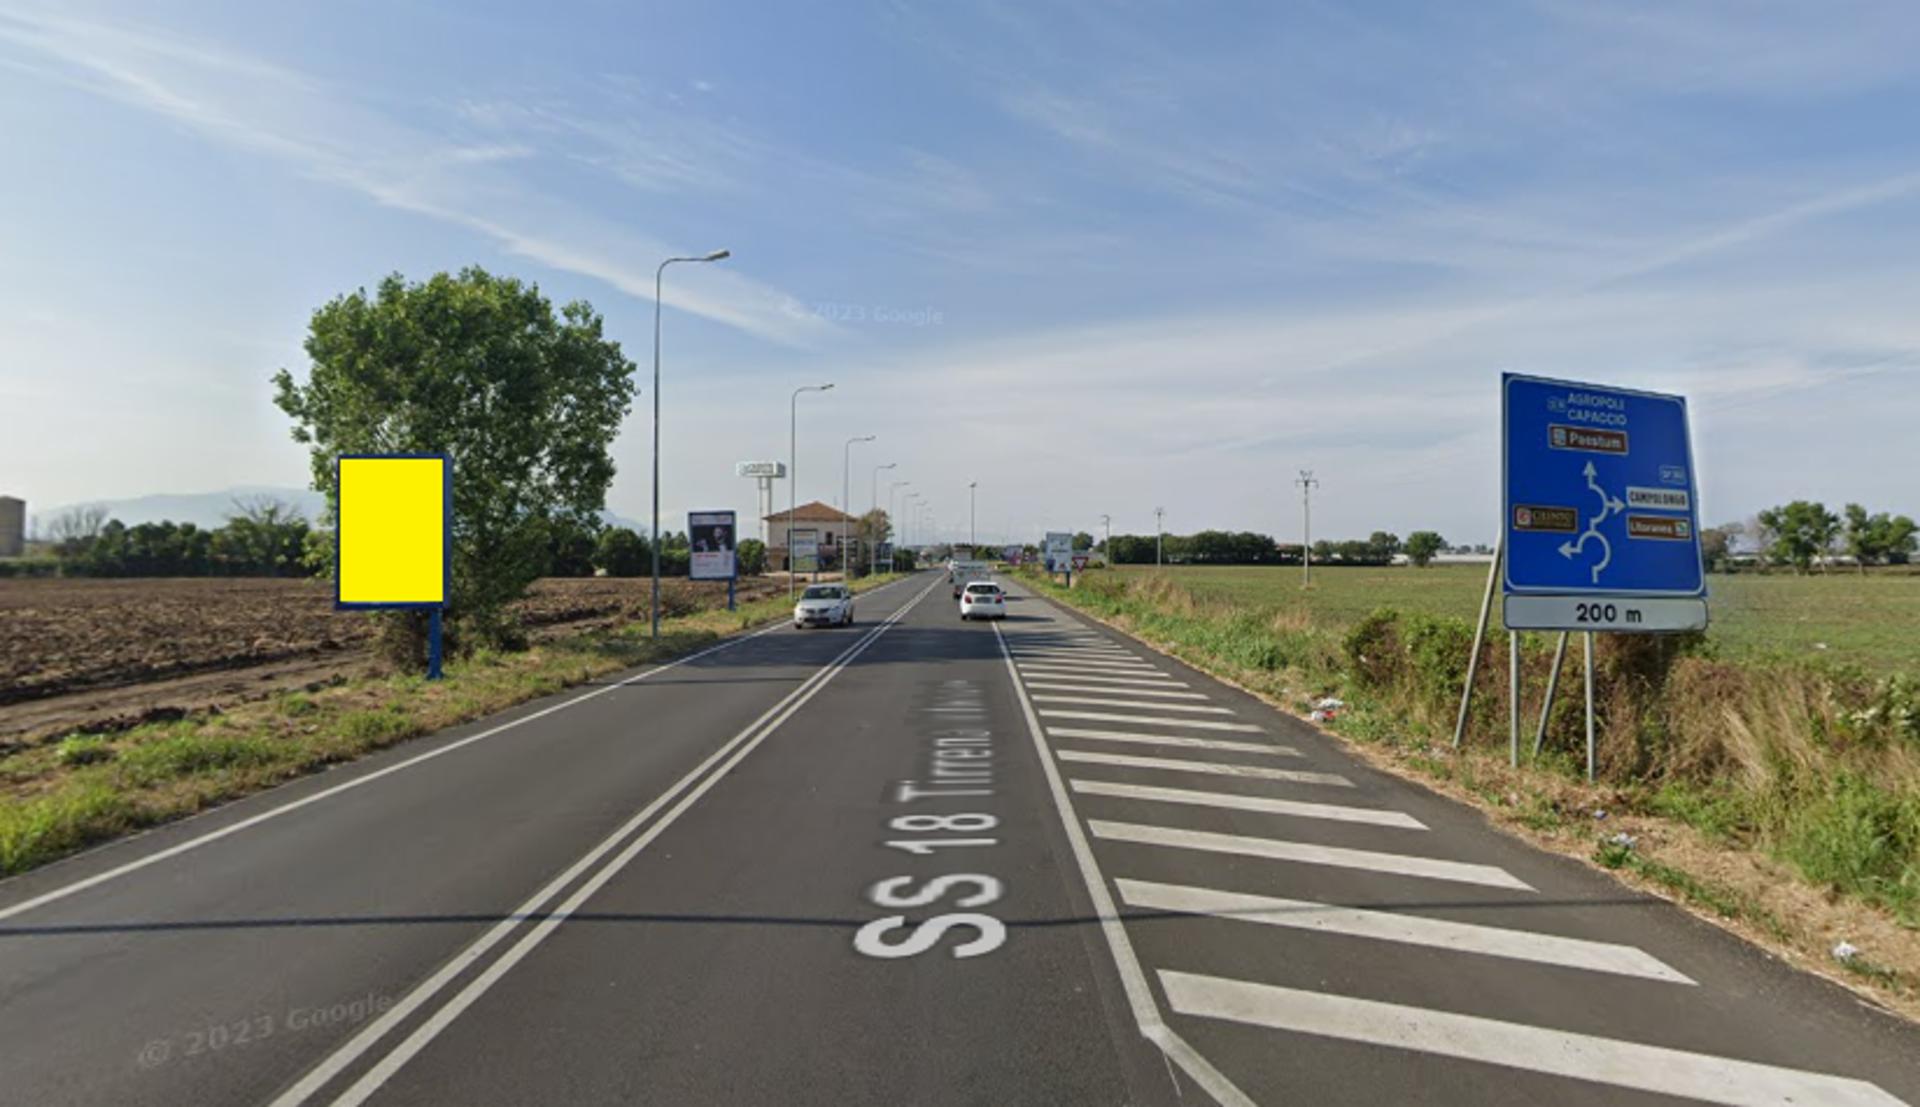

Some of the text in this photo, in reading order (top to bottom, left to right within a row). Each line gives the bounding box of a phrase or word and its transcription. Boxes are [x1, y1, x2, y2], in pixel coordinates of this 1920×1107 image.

[1567, 393, 1625, 410] AGROPOLI
[1567, 409, 1628, 426] CAPACCIO
[1576, 603, 1642, 623] 200 m
